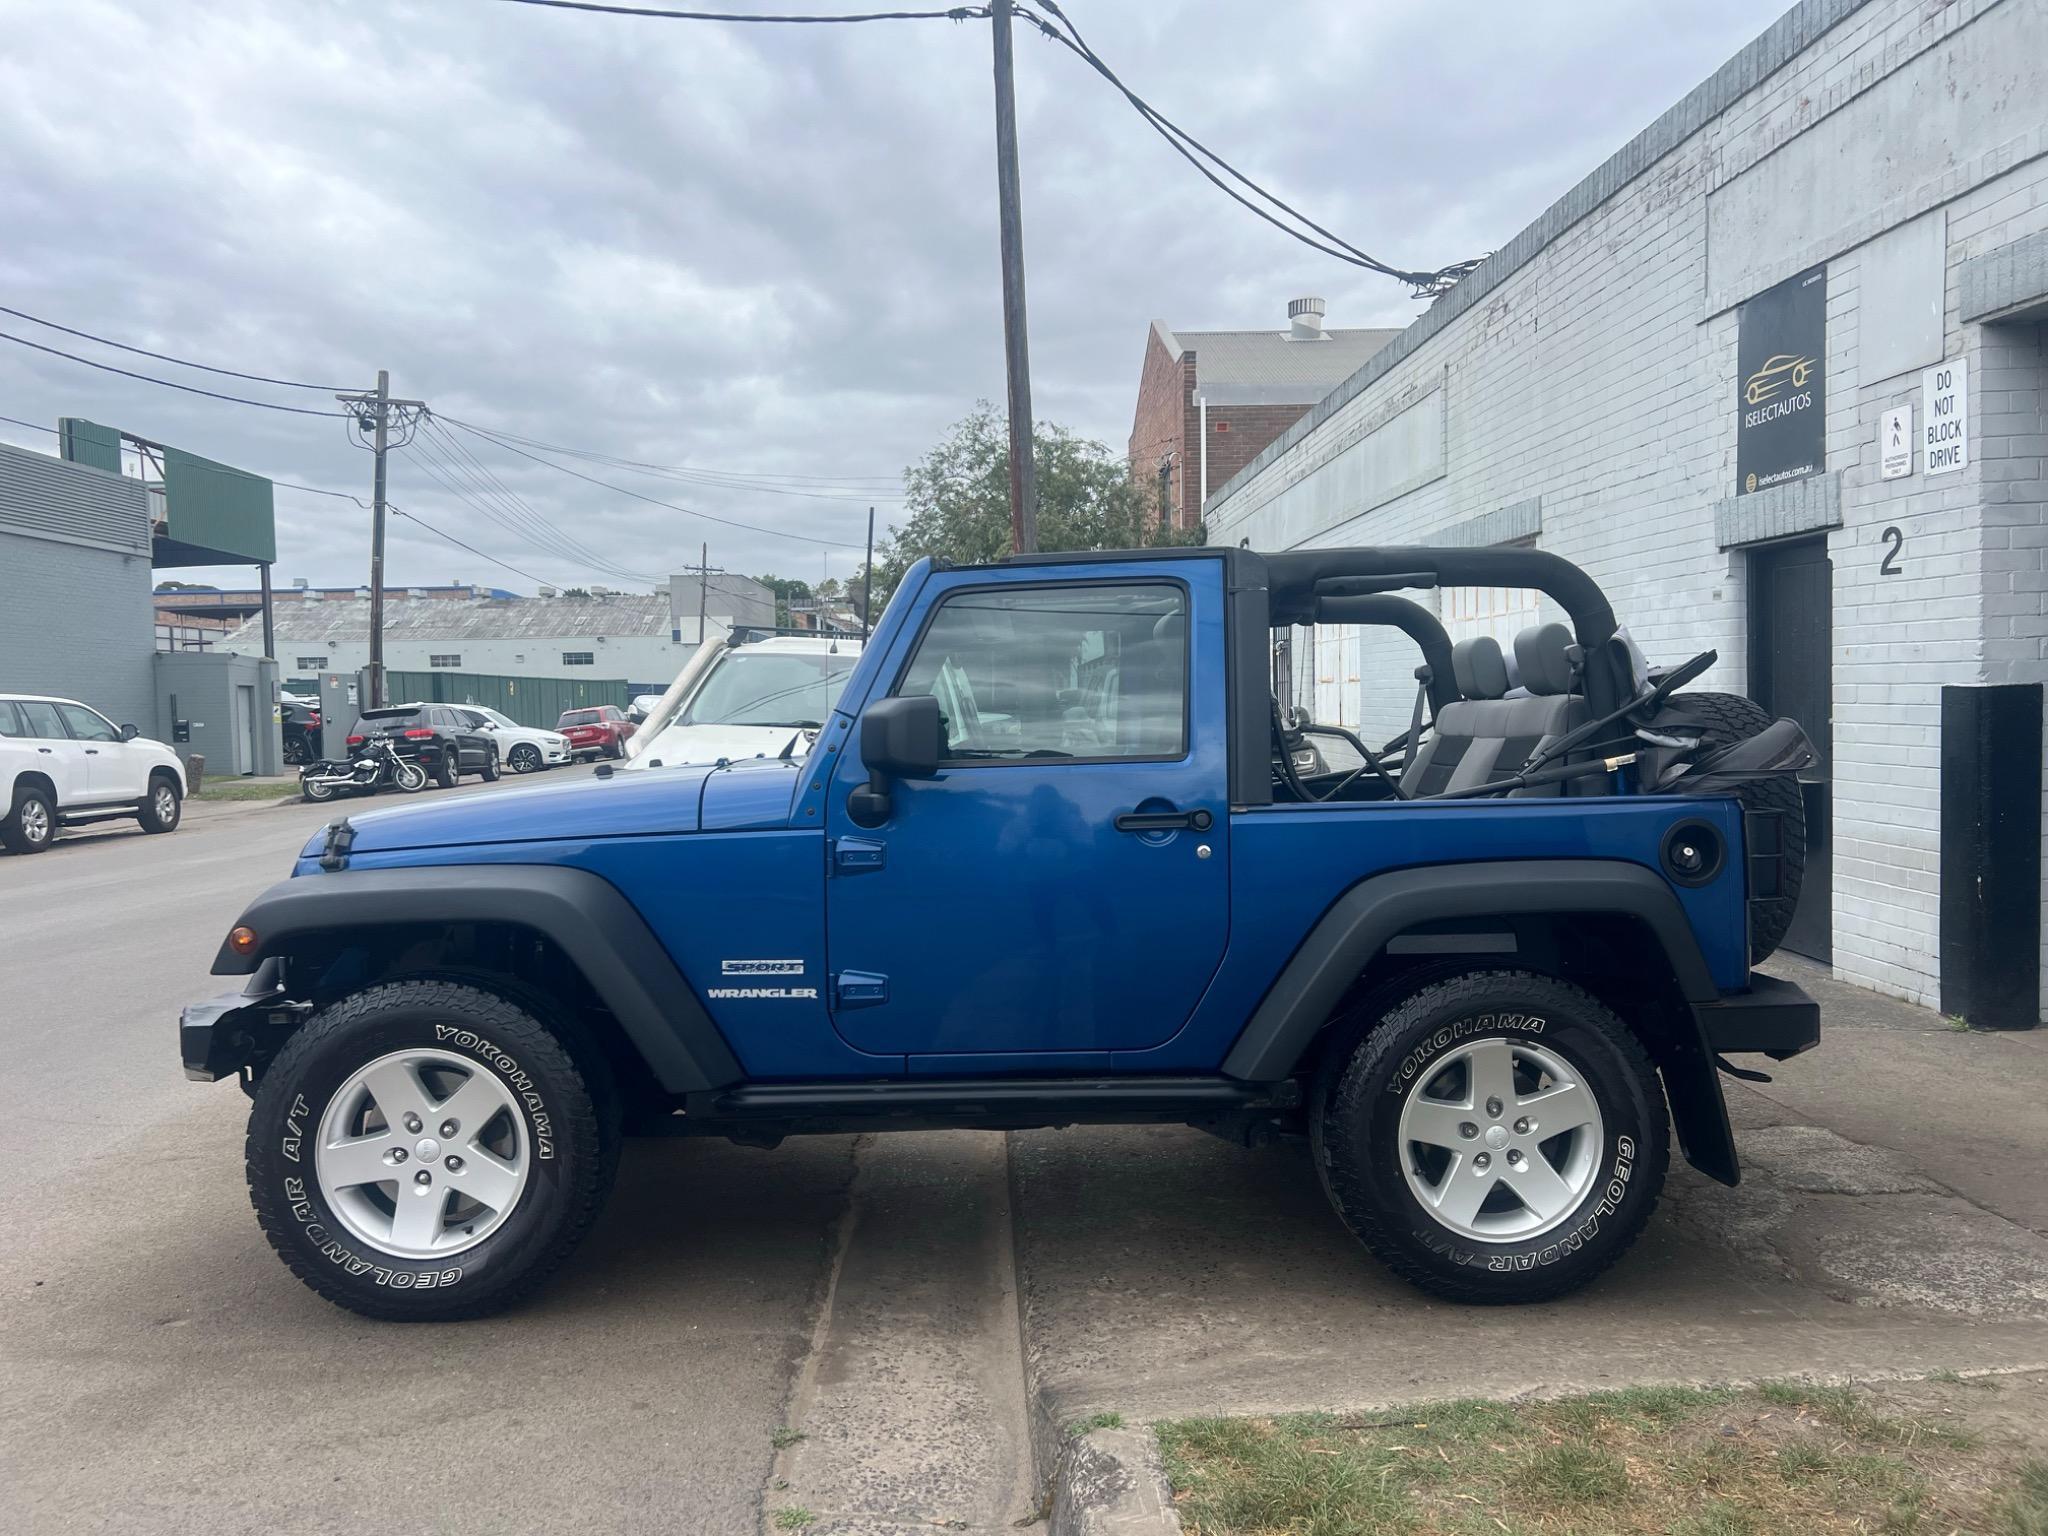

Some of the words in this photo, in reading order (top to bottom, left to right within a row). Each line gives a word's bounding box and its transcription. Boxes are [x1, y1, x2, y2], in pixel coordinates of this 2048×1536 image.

[1937, 370, 1952, 391] DO
[1745, 391, 1812, 429] ISELECTAUTOS
[1934, 394, 1955, 418] NOT
[1927, 418, 1962, 445] BLOCK
[1930, 445, 1961, 469] DRIVE
[1880, 526, 1903, 576] 2
[707, 988, 818, 999] WRANGLER
[1386, 1013, 1547, 1095] YOKOHAMA
[435, 1024, 554, 1160] YOKOHAMA
[282, 1093, 311, 1162] A/T
[1488, 1135, 1635, 1272] GEOLANDAR
[285, 1177, 463, 1289] GEOLANDAR
